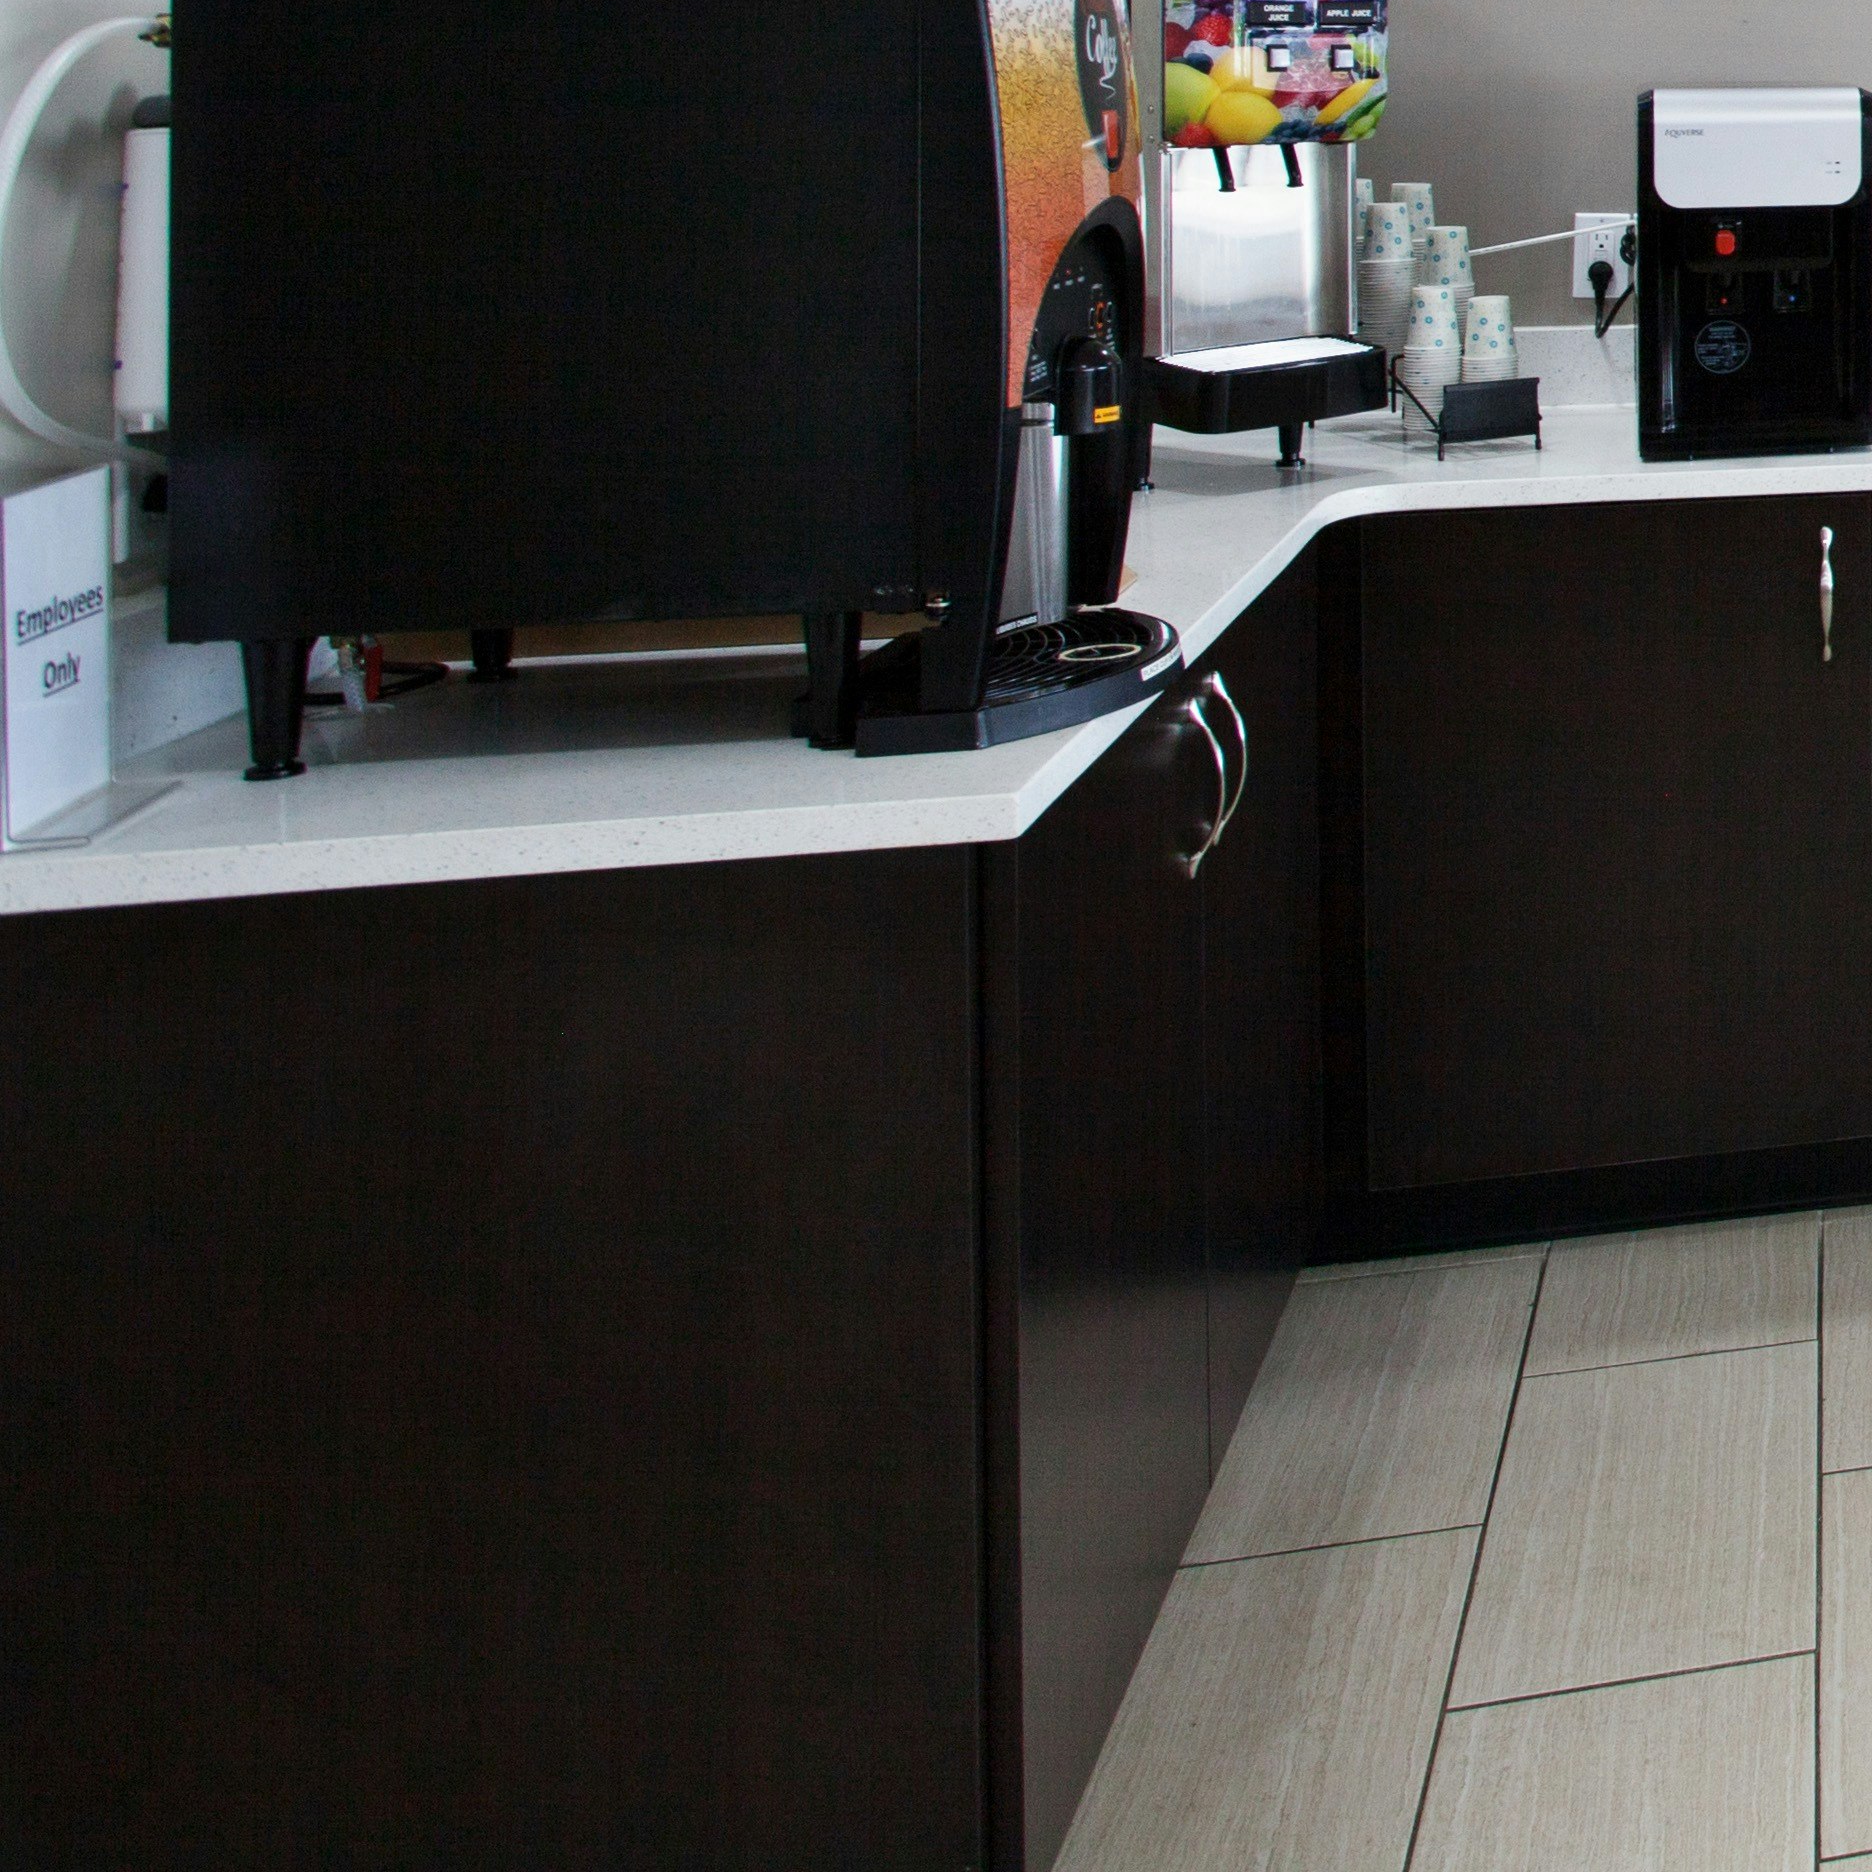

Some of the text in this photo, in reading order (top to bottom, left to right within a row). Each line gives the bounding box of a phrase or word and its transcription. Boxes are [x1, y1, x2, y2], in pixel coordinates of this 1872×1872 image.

[1263, 4, 1295, 13] ORANGE
[1268, 14, 1290, 22] JUICE
[1326, 9, 1372, 18] APPLE JUICE
[17, 585, 103, 639] Employees
[44, 651, 81, 689] Only
